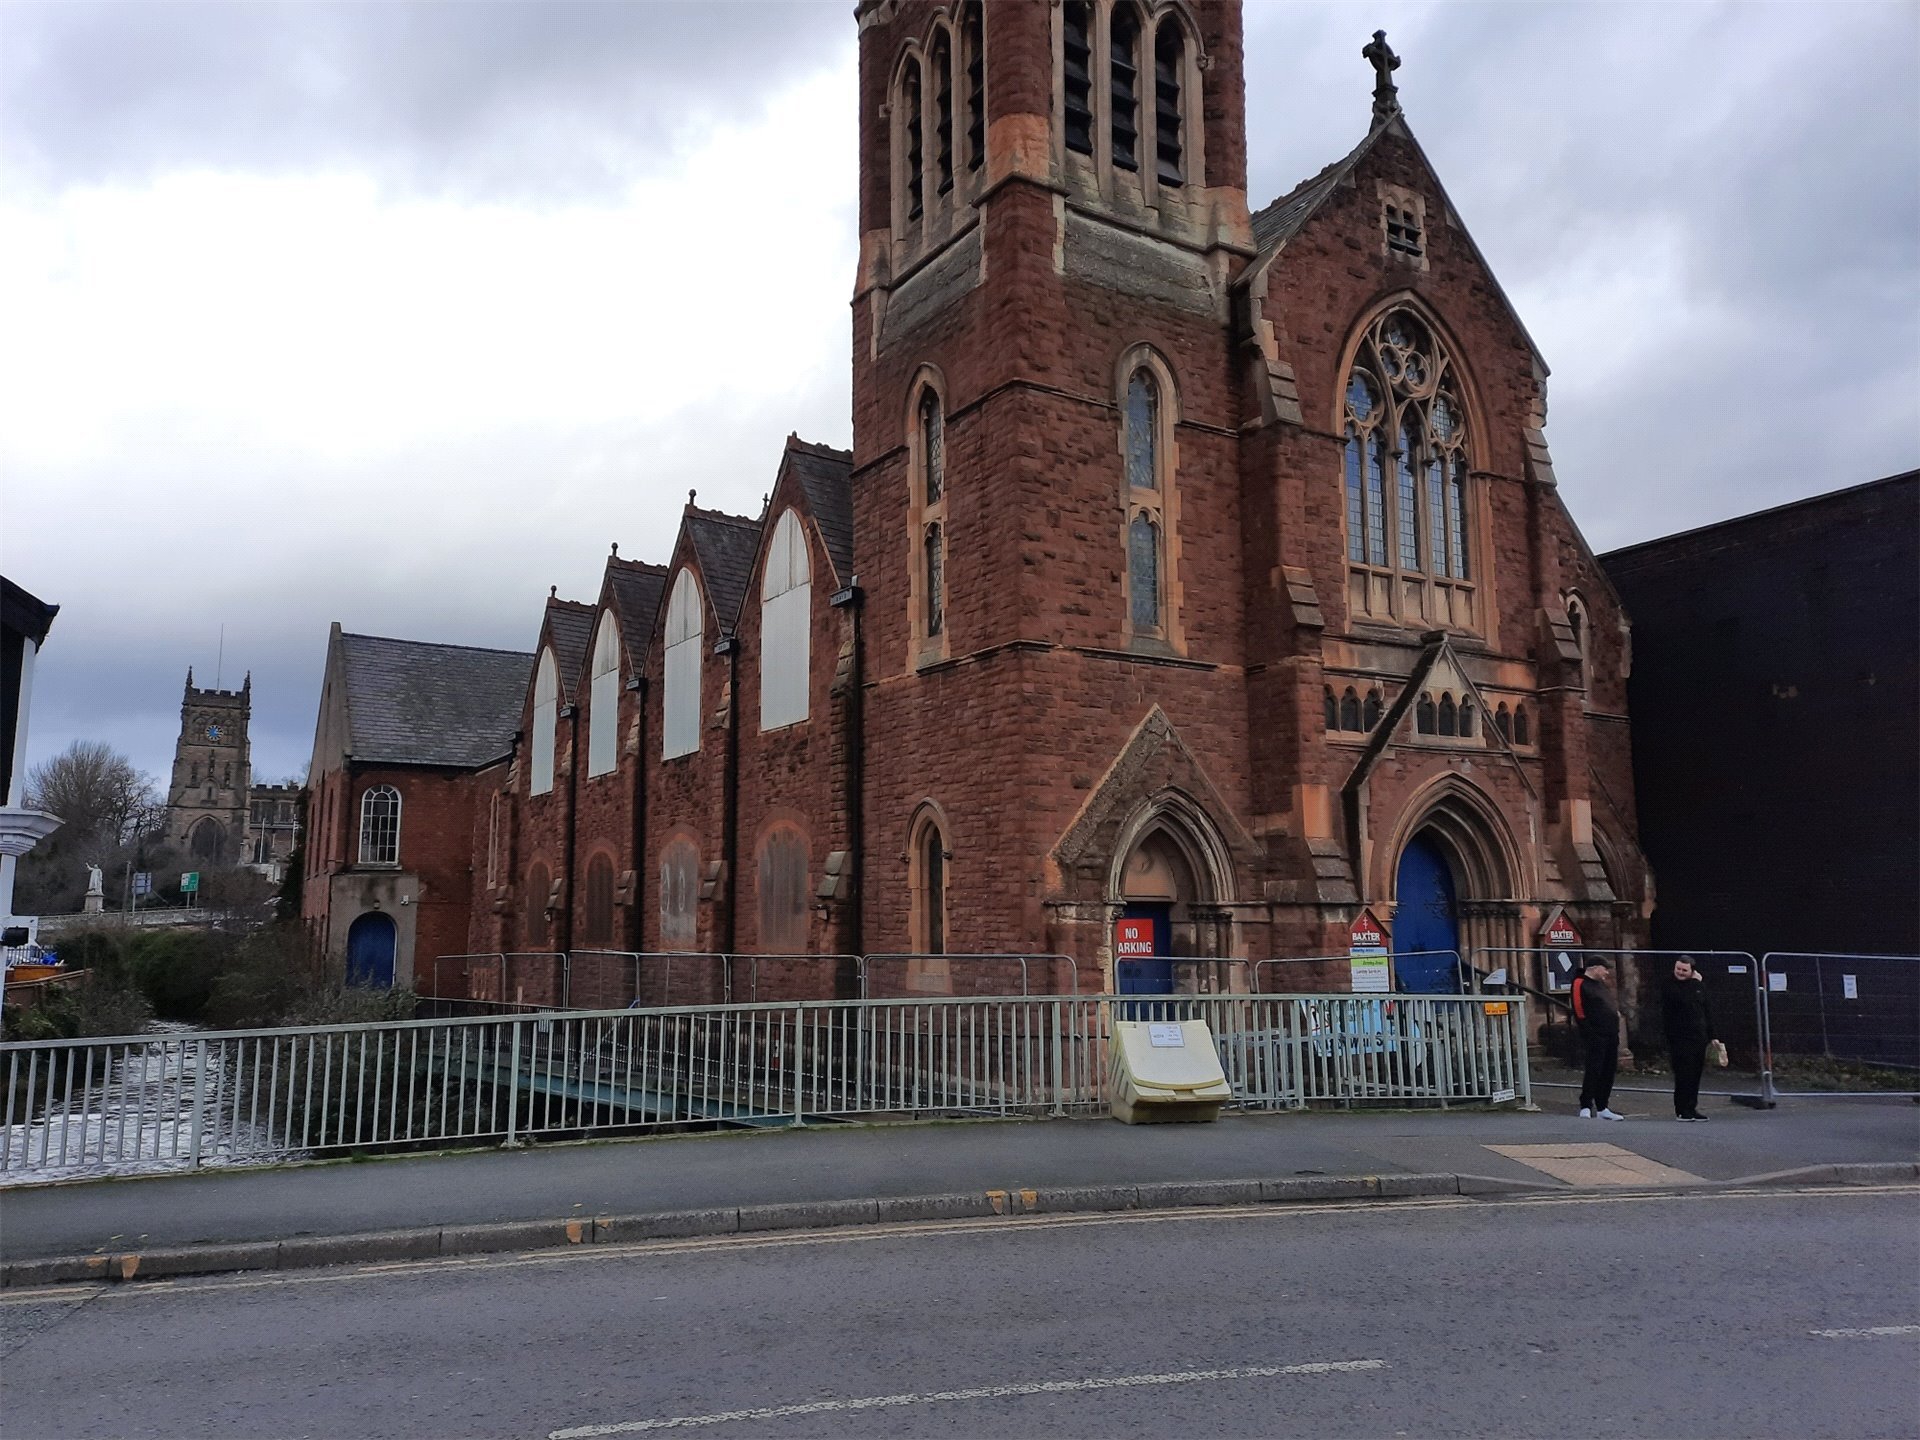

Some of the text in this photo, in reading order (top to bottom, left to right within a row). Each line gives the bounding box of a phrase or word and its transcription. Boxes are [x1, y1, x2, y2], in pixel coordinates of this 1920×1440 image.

[1125, 927, 1138, 939] NO
[1352, 931, 1380, 941] BAXTER
[1550, 929, 1574, 939] BAXTER
[1118, 941, 1152, 954] ARKING
